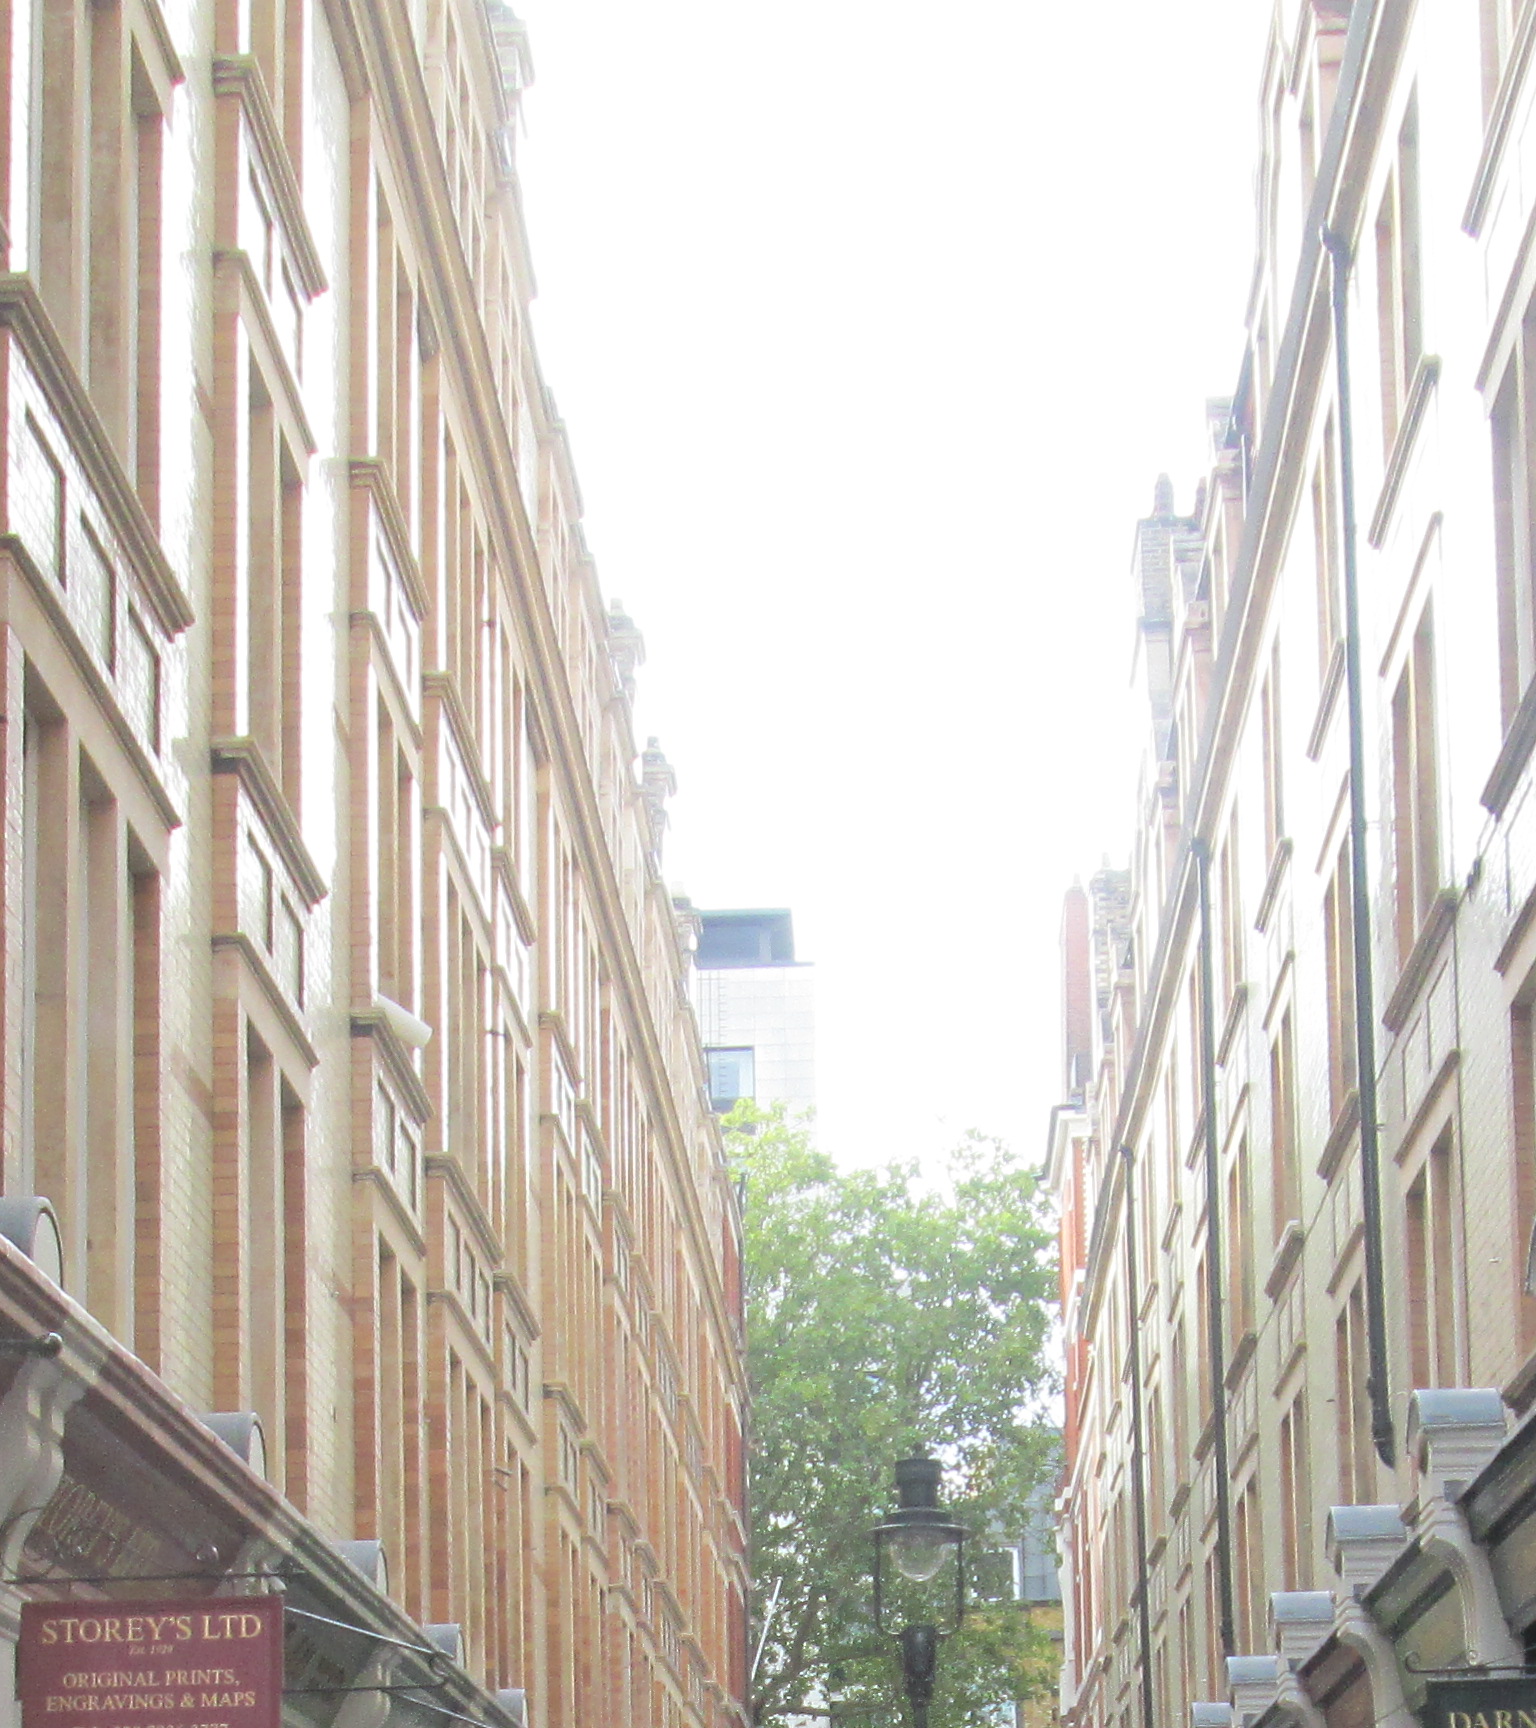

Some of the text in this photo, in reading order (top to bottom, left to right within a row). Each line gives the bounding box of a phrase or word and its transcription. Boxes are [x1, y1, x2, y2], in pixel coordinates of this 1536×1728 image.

[41, 1613, 263, 1645] STOREY'S LTD
[63, 1668, 241, 1689] ORIGINAL PRINTS,
[46, 1690, 257, 1713] ENGRAVINGS & MAPS
